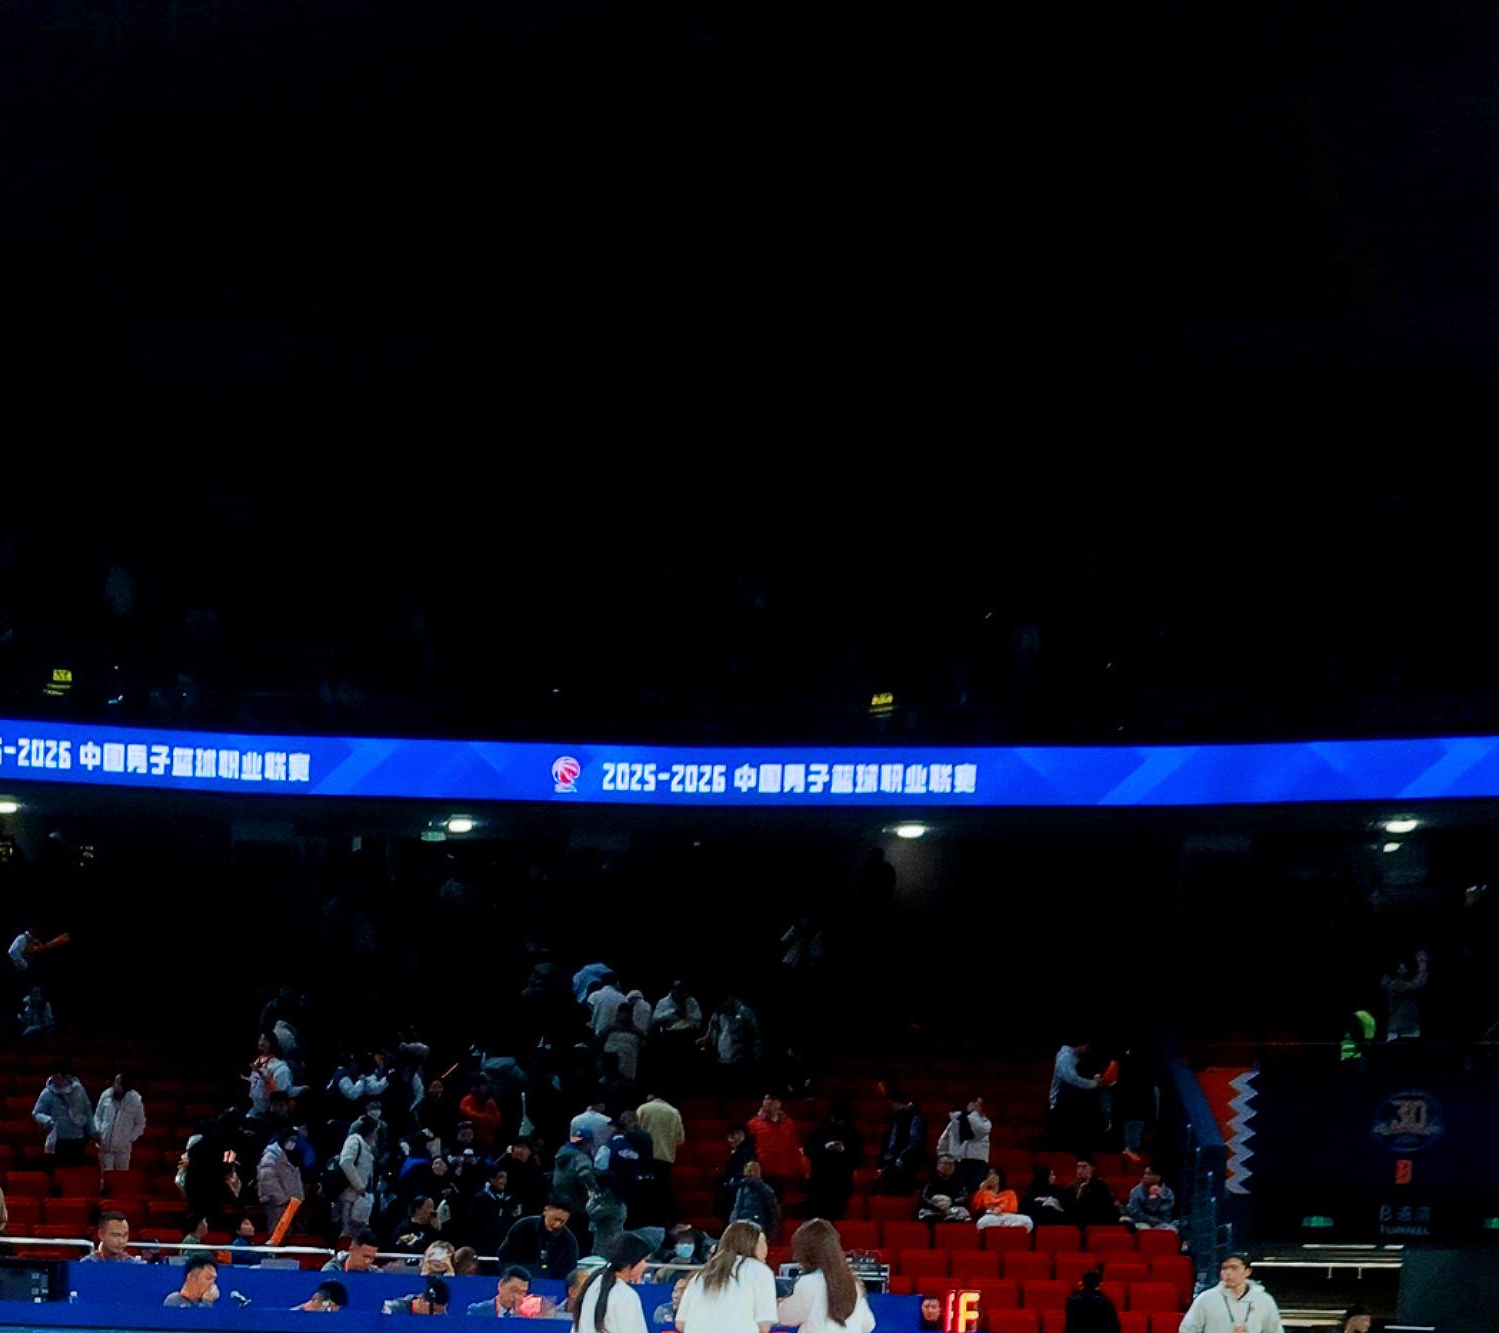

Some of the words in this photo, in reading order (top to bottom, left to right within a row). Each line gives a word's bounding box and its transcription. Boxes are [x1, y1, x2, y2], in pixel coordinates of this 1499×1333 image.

[80, 741, 311, 782] 中国男子篮球职业联赛
[602, 763, 727, 793] 2025-2026
[734, 763, 978, 794] 中国男子篮球职业联赛
